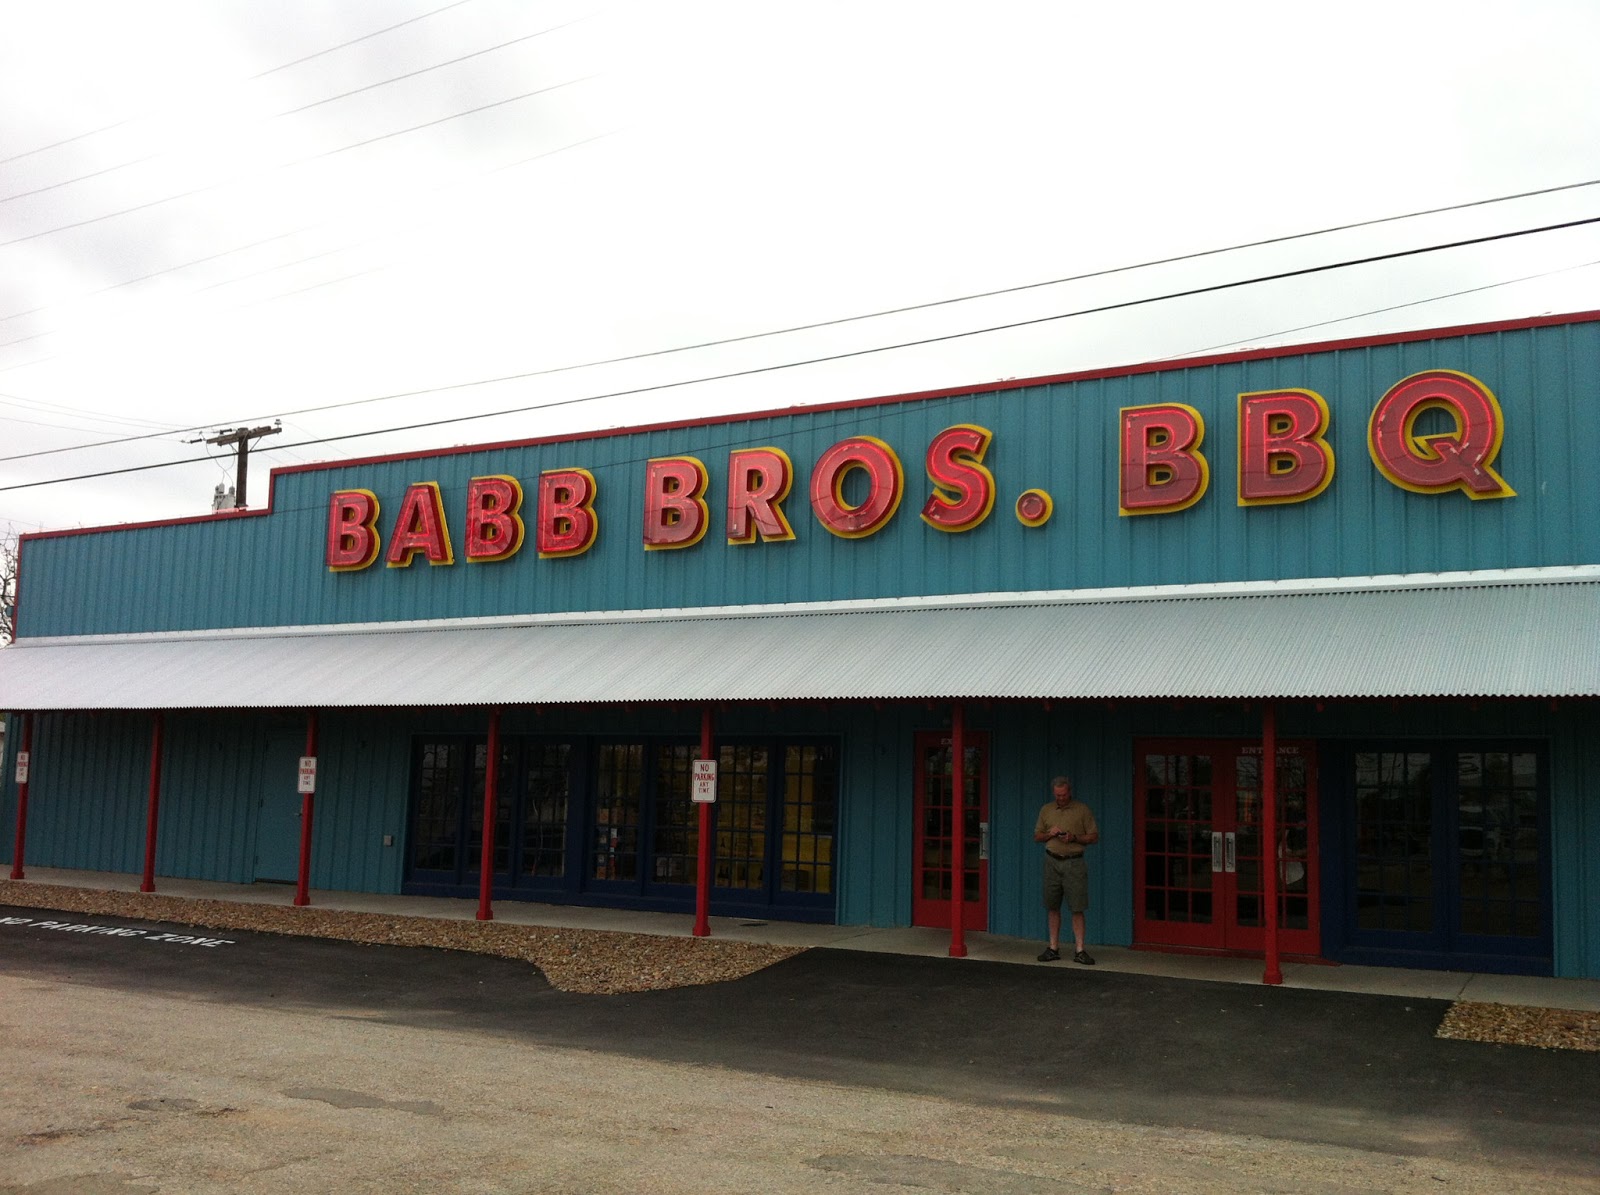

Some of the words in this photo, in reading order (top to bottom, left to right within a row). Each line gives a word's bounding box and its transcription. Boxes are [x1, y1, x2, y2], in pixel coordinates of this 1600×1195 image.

[326, 467, 598, 572] BABB
[642, 424, 1053, 551] BROS.
[1119, 369, 1518, 517] BBQ
[1241, 746, 1300, 754] ENTNCE
[700, 763, 710, 772] NO
[694, 773, 715, 781] PARKING
[28, 920, 147, 938] PARKING
[144, 932, 236, 948] ZONE
